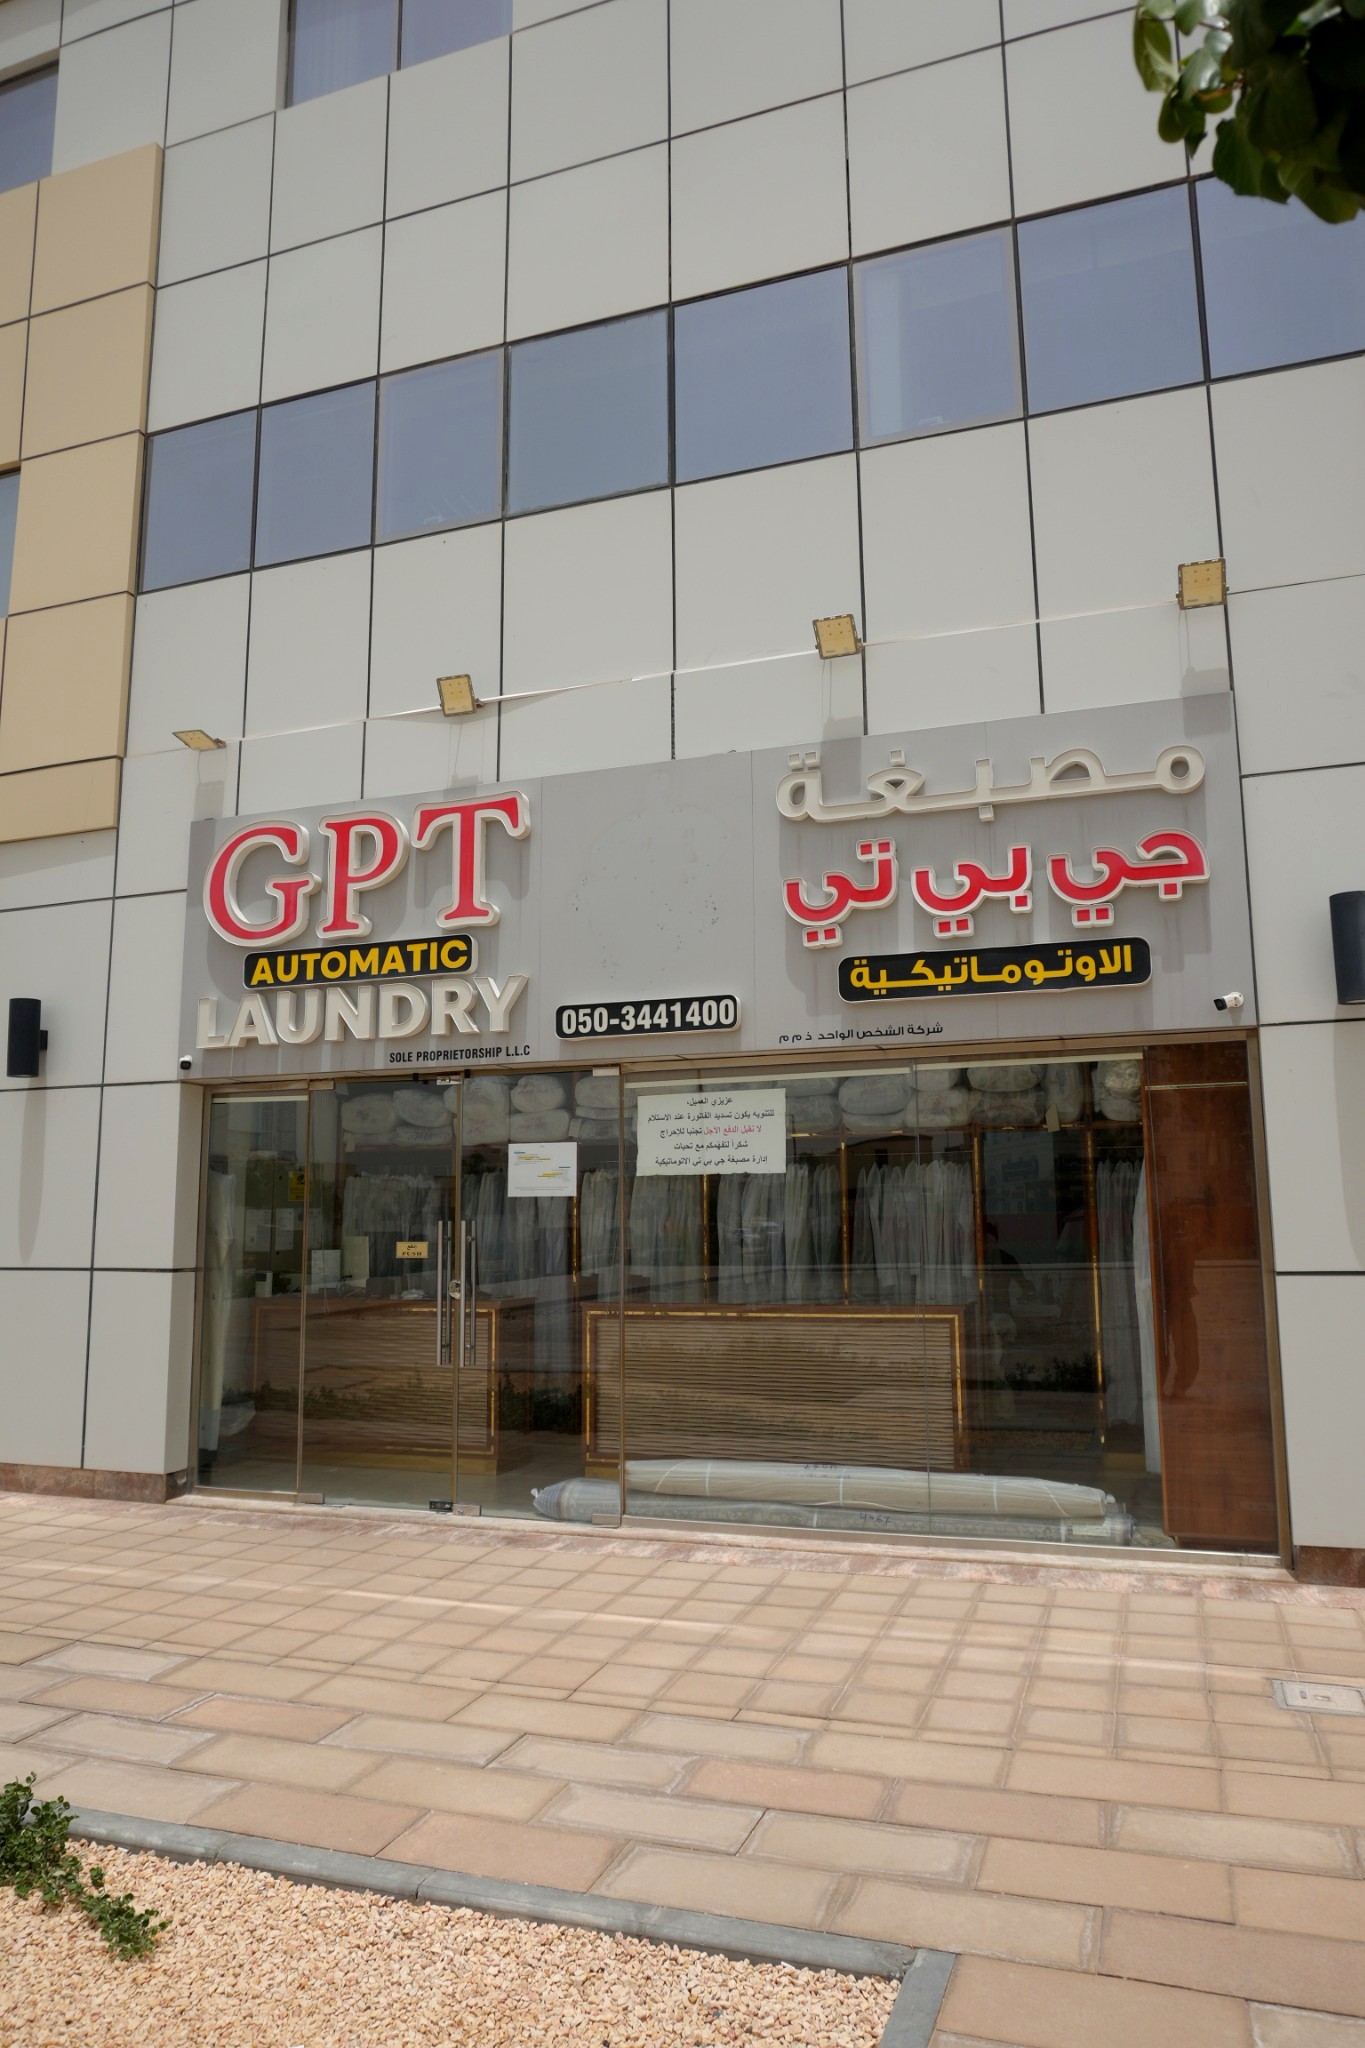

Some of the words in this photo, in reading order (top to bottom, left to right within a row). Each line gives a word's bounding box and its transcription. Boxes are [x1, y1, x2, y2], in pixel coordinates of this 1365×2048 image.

[776, 745, 1205, 823] مصبغة
[203, 791, 532, 947] GPT
[782, 837, 898, 948] تي
[911, 843, 1033, 939] بي
[1047, 828, 1210, 928] جي
[250, 939, 468, 985] AUTOMATIC
[849, 944, 1133, 995] الاوتوماتيكية
[196, 974, 528, 1049] LAUNDRY
[561, 998, 736, 1034] 050-3441400
[817, 1029, 854, 1041] الواحد
[856, 1024, 905, 1039] الشخص
[907, 1021, 944, 1036] شركة
[389, 1051, 413, 1063] SOLE
[416, 1046, 502, 1062] PROPRIETORSHIP
[505, 1044, 530, 1057] L.L.C
